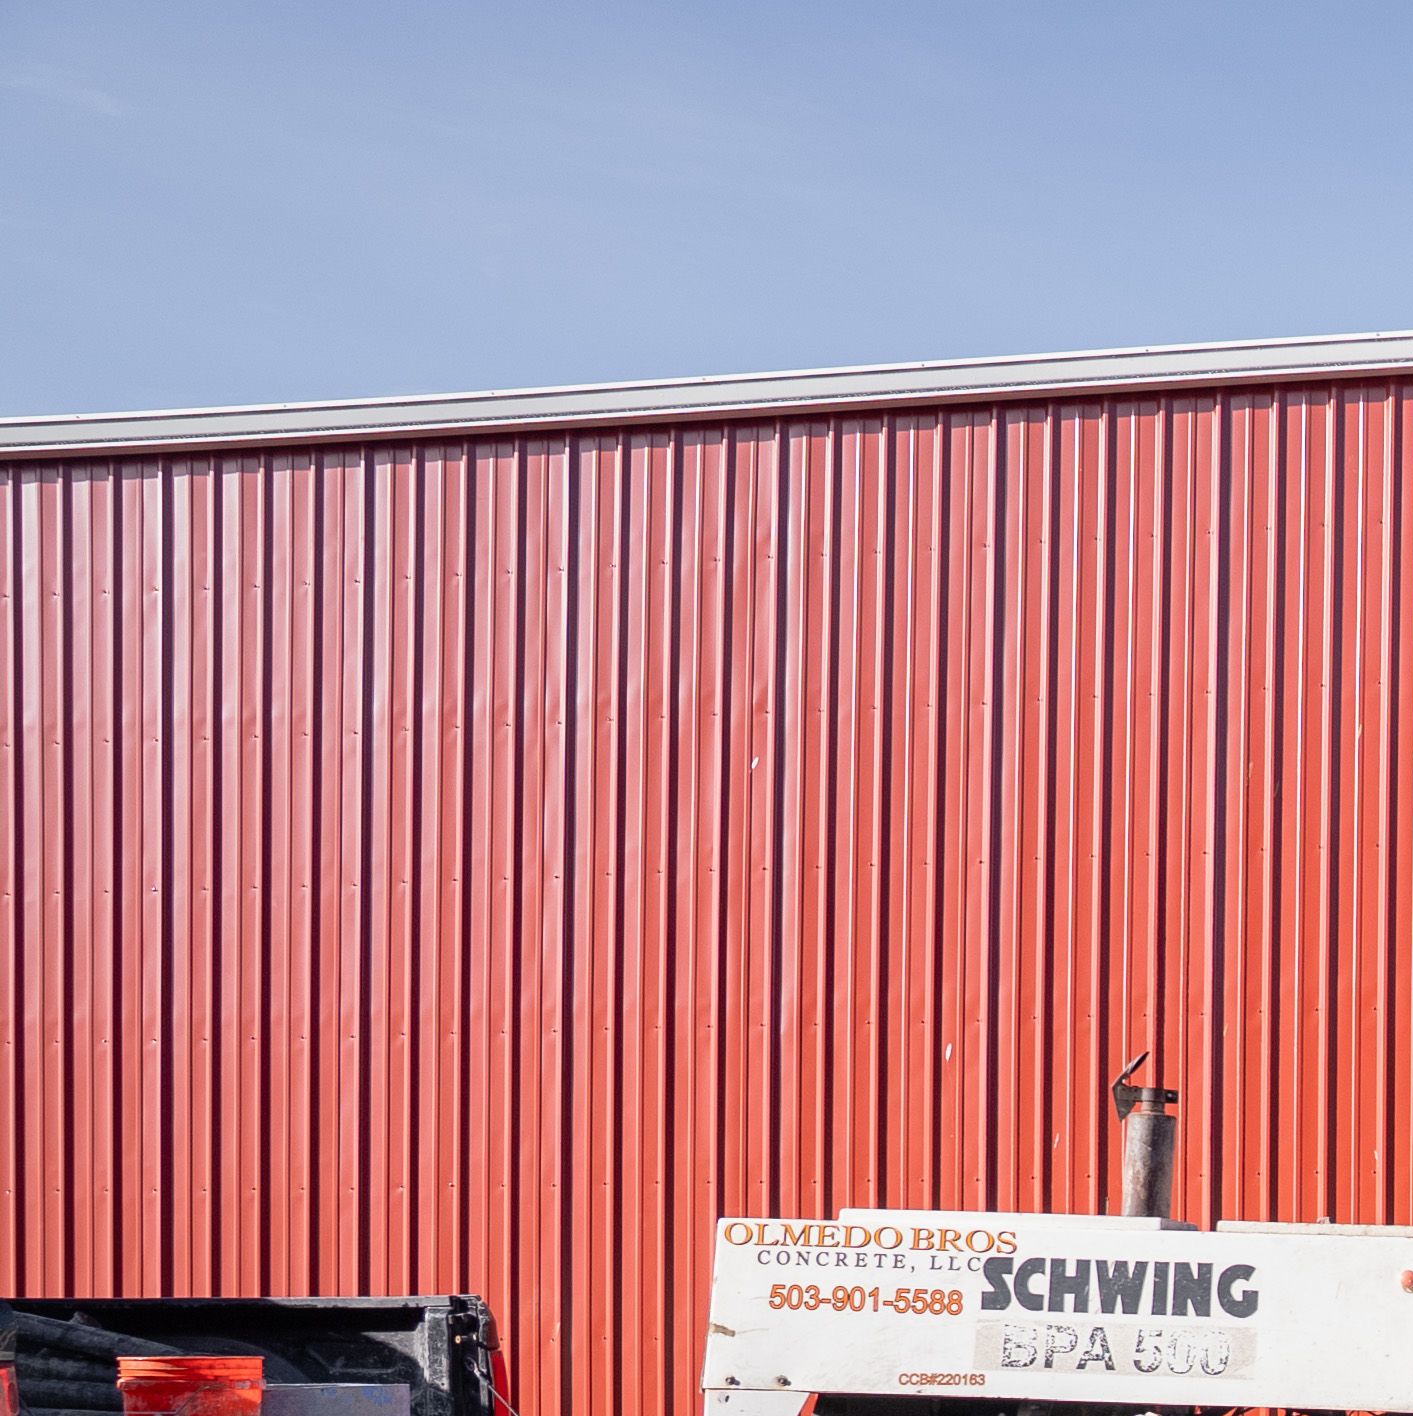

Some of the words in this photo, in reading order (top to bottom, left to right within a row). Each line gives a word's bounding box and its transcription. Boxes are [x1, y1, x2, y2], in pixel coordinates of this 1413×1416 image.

[724, 1222, 903, 1251] OLMEDO
[910, 1227, 1018, 1255] BROS
[757, 1250, 916, 1273] CONCRETE,
[930, 1256, 981, 1272] LLC
[768, 1284, 965, 1316] 503-901-5588
[981, 1257, 1260, 1318] SCHWING
[1000, 1324, 1116, 1371] BPA
[1133, 1329, 1230, 1376] 500
